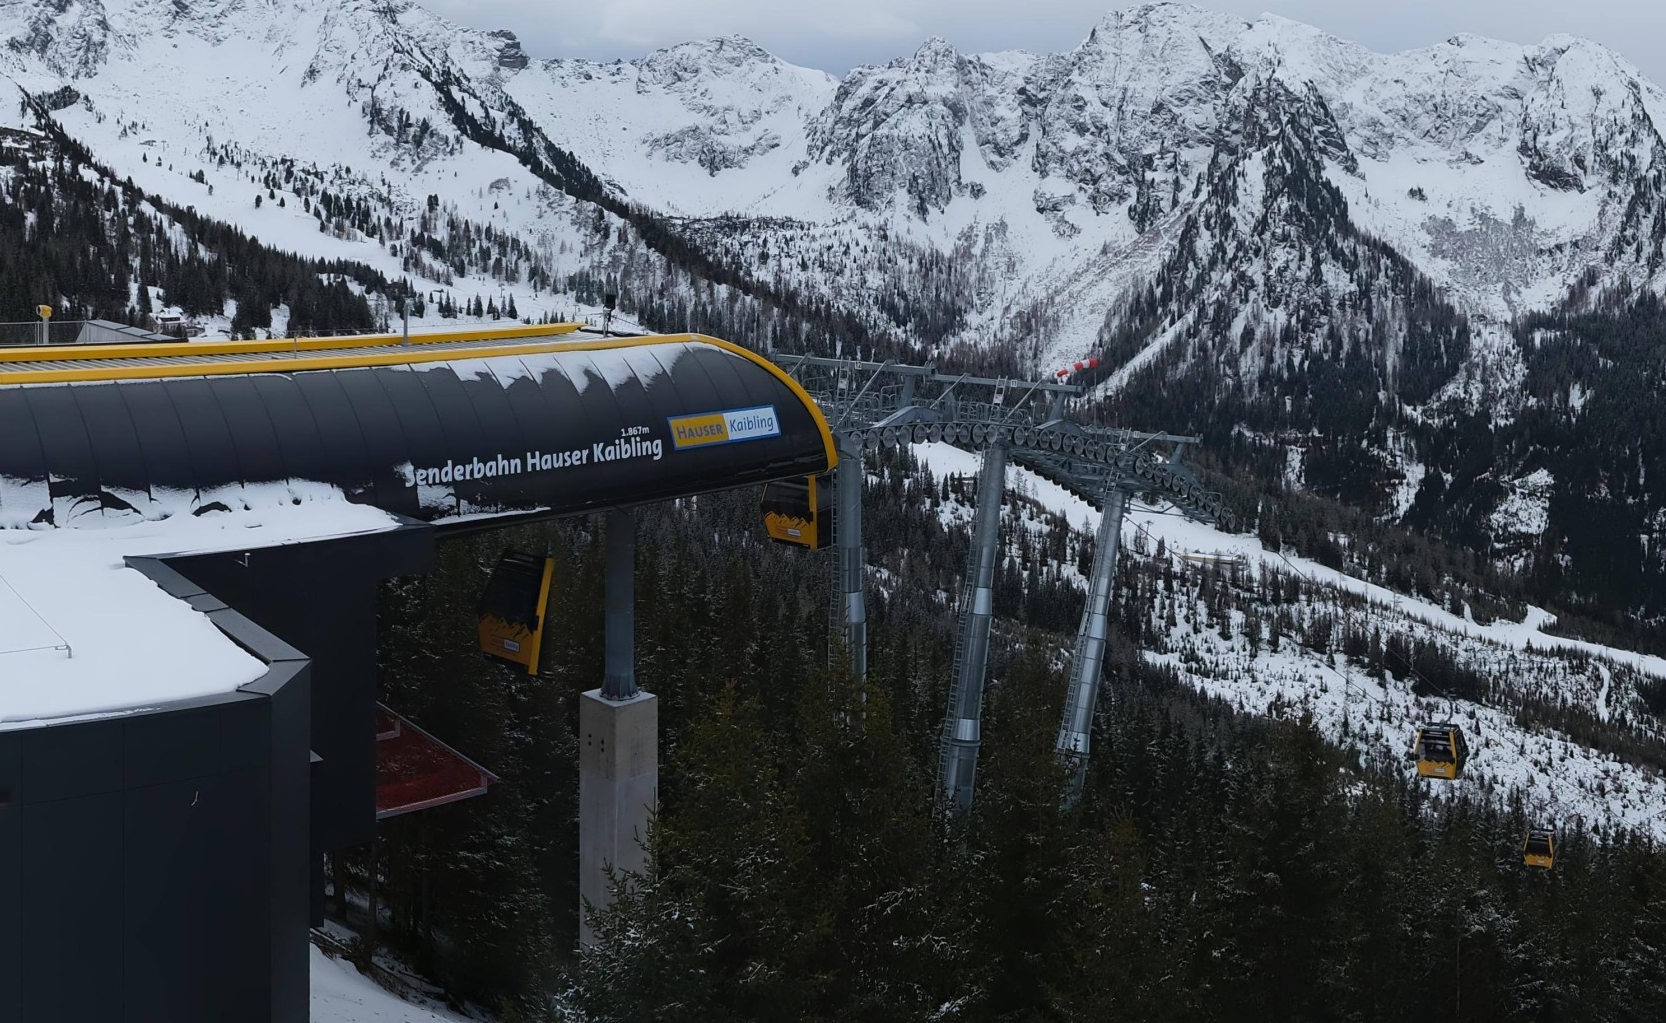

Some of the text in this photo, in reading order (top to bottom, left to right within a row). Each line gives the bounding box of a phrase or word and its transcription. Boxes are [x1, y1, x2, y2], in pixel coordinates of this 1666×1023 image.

[620, 425, 650, 437] 1.867m
[729, 415, 774, 433] Kaibling
[405, 436, 663, 488] Senderbahn Hauser Kaibling
